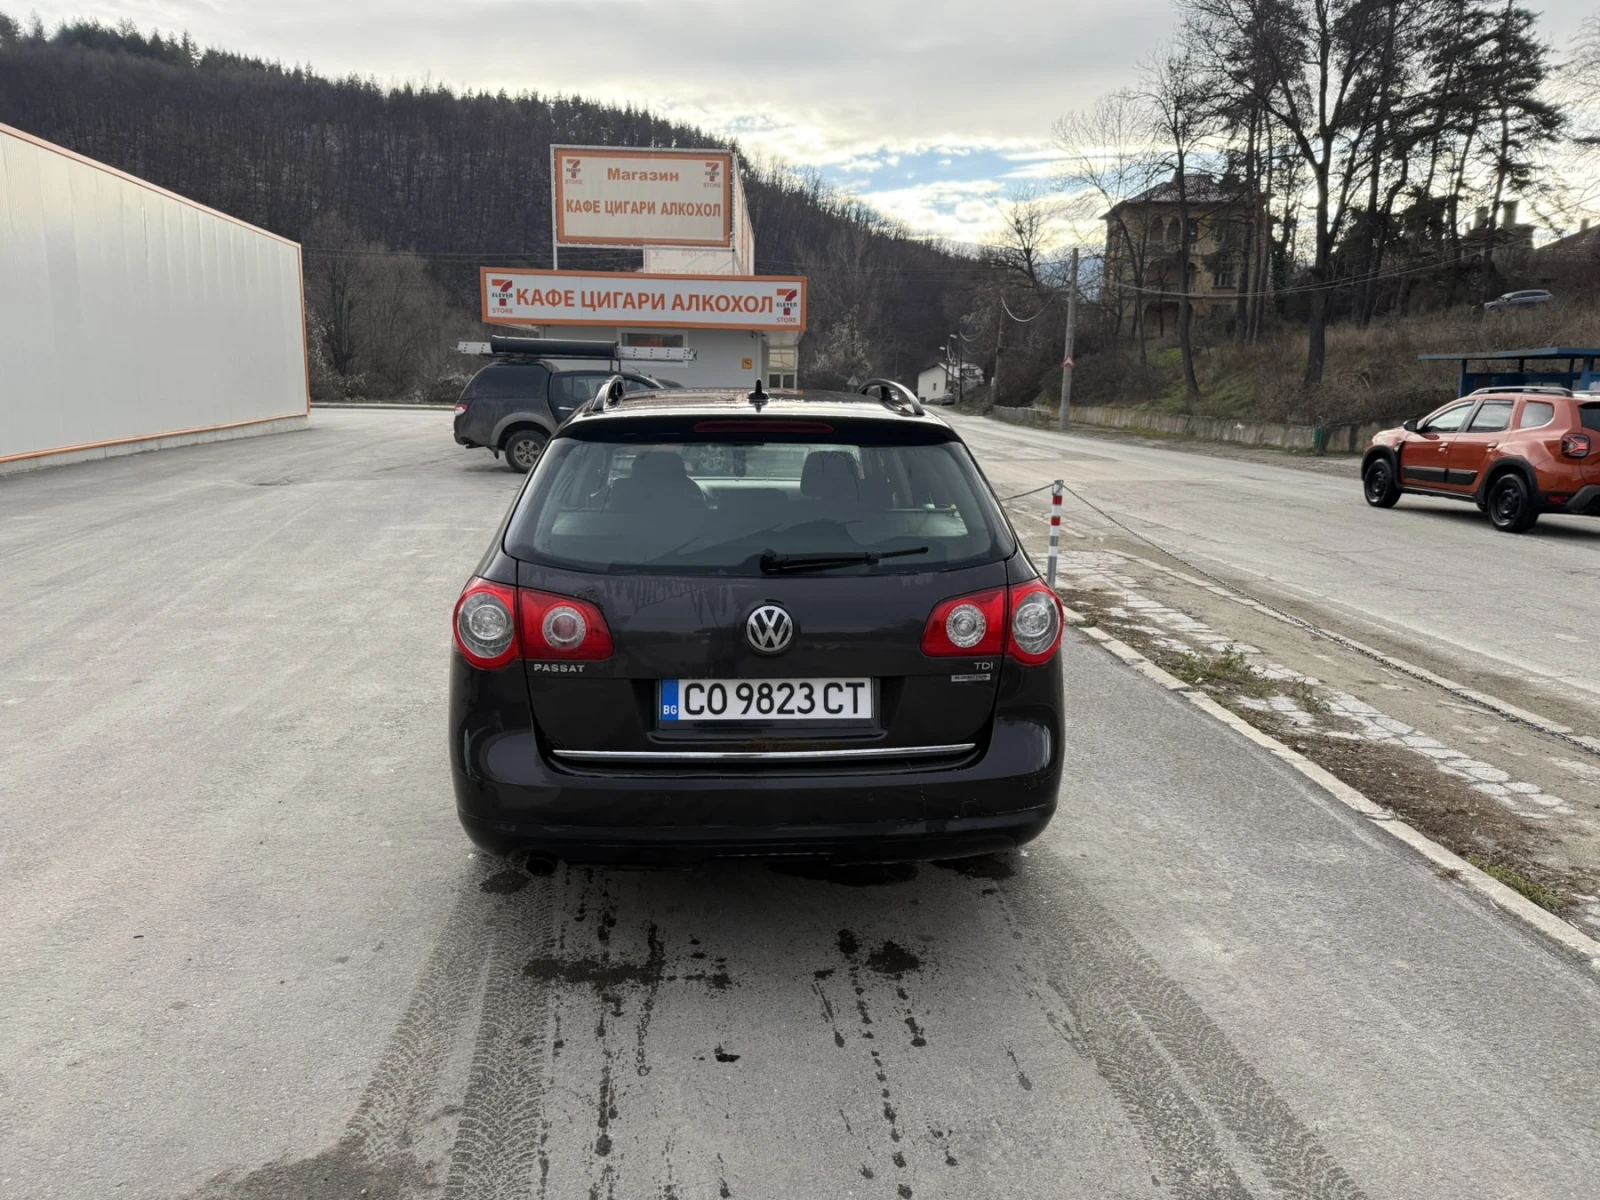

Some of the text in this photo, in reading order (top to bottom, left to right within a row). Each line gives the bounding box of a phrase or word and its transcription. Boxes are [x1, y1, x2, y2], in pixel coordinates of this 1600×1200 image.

[607, 168, 679, 182] Магазин
[566, 199, 721, 217] КАФЕ ЦИГАРИ АЛКОХОЛ
[491, 279, 513, 306] 7
[516, 288, 773, 313] КАФЕ ЦИГАРИ АЛКОХОЛ
[776, 288, 797, 316] 7
[491, 307, 513, 315] STORE
[533, 663, 585, 673] PASSAT
[973, 661, 994, 670] TDI
[735, 682, 816, 715] 9823
[823, 682, 865, 715] CT
[663, 705, 677, 715] BG
